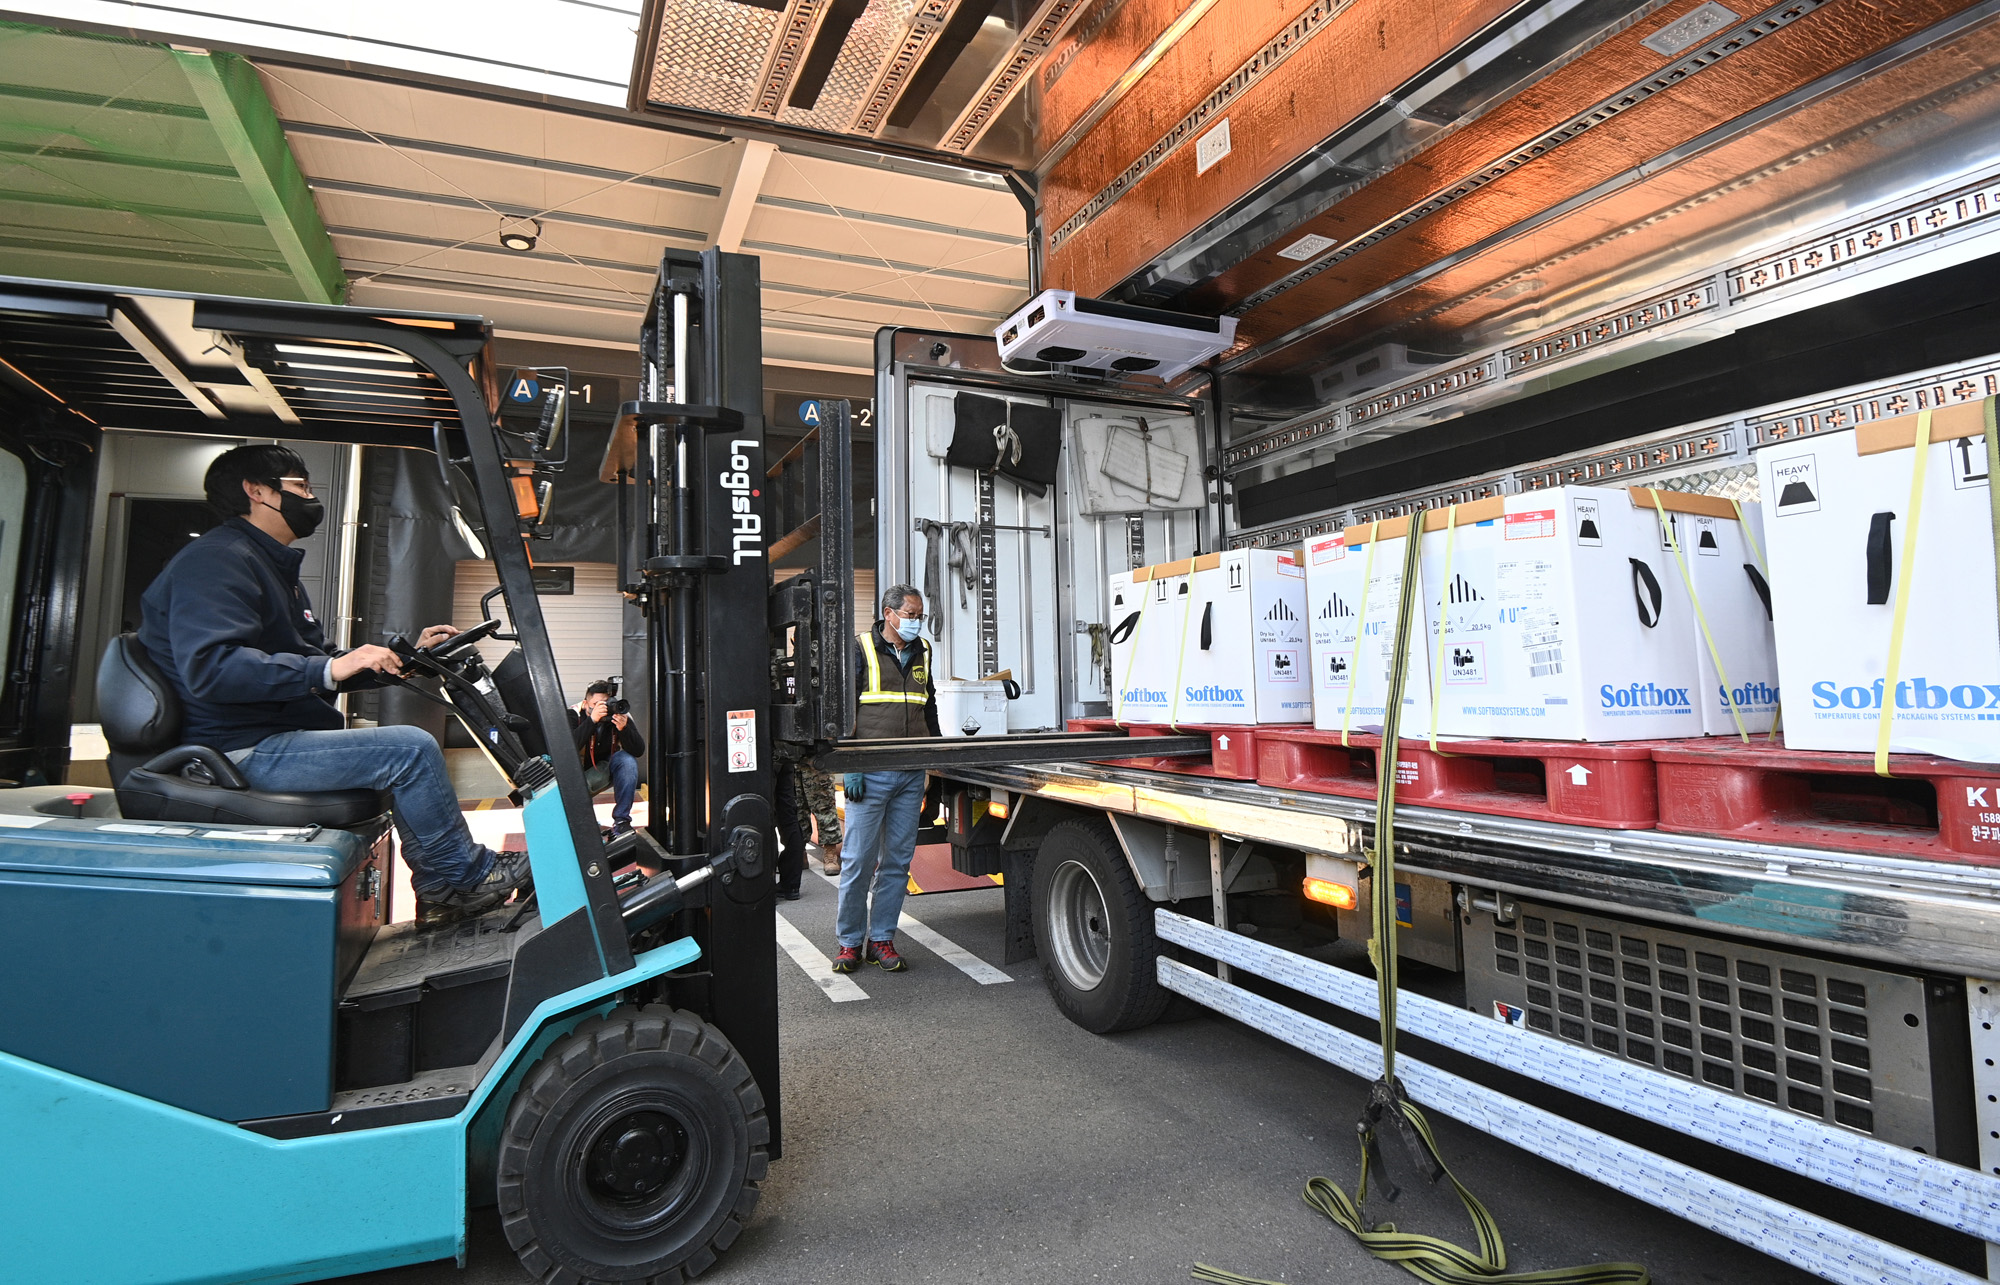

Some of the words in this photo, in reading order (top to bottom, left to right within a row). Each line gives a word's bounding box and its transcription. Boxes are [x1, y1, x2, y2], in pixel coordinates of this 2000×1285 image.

[513, 378, 532, 399] A
[804, 403, 820, 422] A
[1776, 463, 1810, 477] HEAVY
[719, 439, 762, 566] LogisALL
[1577, 505, 1596, 513] HEAVY
[1697, 517, 1713, 525] HEAVY
[1433, 627, 1454, 635] UN845
[1185, 685, 1245, 702] Softbox
[1600, 682, 1690, 708] Softbox
[1462, 706, 1546, 717] WWW.SOFTBOXSYSTEMS.COM
[1814, 712, 1861, 720] TEMPERATURE
[1897, 713, 1938, 721] PACKAGING
[1941, 713, 1976, 721] SYSTEMS
